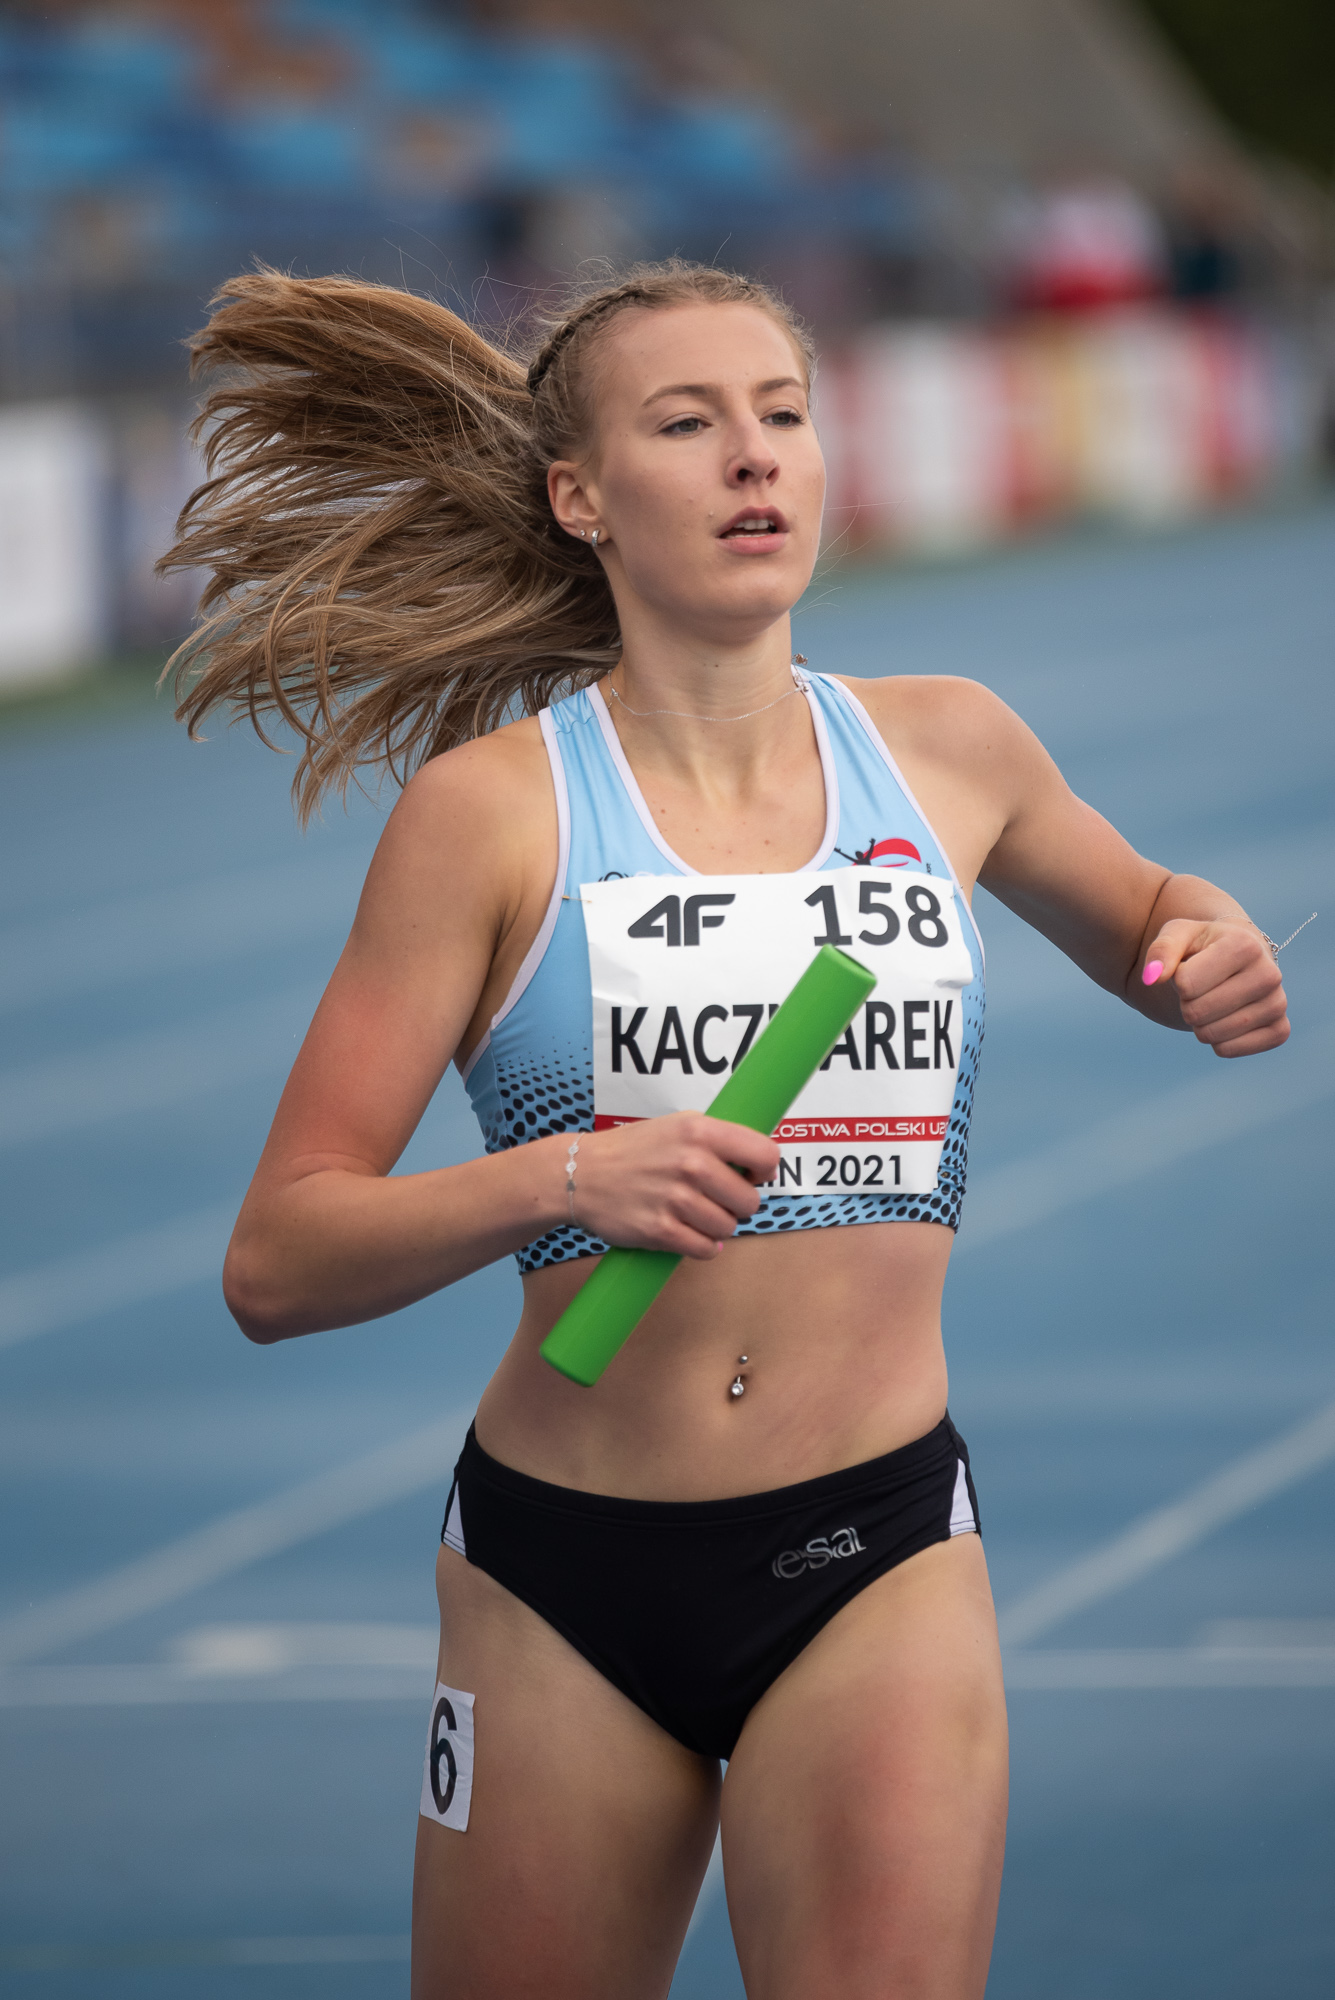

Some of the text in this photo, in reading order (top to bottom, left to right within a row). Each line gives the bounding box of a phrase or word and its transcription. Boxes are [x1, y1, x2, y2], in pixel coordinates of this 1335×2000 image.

[804, 880, 949, 948] 158
[611, 1000, 956, 1076] KACZAREK
[855, 1122, 926, 1137] POLSKI
[816, 1155, 901, 1187] 2021
[430, 1697, 458, 1815] 6
